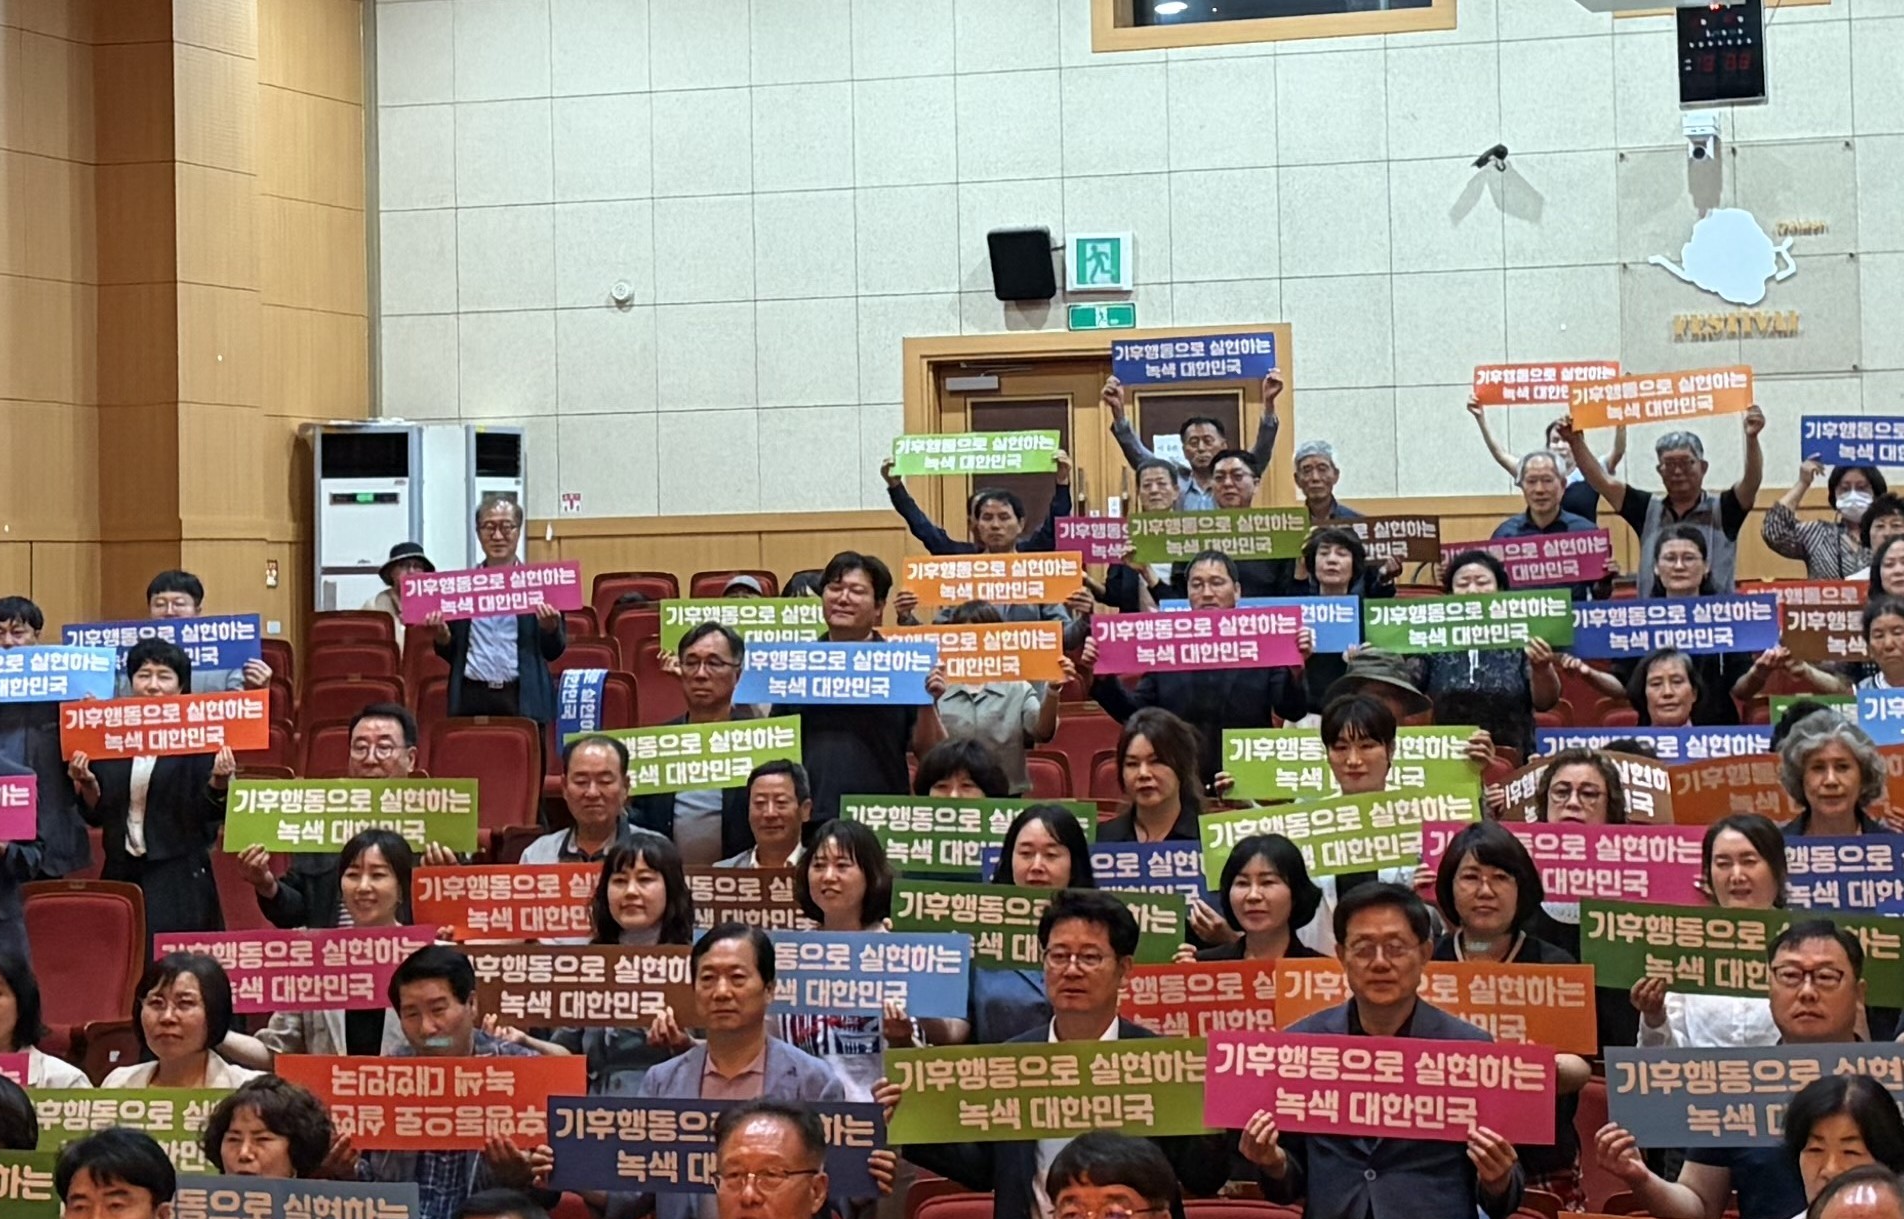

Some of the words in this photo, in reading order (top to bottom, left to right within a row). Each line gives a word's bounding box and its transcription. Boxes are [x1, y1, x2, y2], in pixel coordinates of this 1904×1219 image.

[1116, 342, 1205, 360] 기후행동으로
[1210, 338, 1270, 356] 실현하는
[1146, 363, 1176, 378] 녹색
[1181, 359, 1241, 376] 대한민국
[1573, 379, 1673, 404] 기후행동으로
[1679, 372, 1747, 393] 실현하는
[1607, 403, 1640, 420] 녹색
[1646, 395, 1713, 416] 대한민국
[896, 437, 987, 454] 기후행동으로
[993, 435, 1054, 451] 실현하는
[1839, 444, 1874, 461] 녹색
[924, 456, 955, 470] 녹색
[960, 454, 1021, 469] 대한민국
[1132, 516, 1231, 535] 기후행동으로
[1237, 514, 1304, 532] 실현하는
[1167, 539, 1199, 556] 녹색
[909, 561, 1006, 579] 기후행동으로
[1012, 559, 1077, 577] 실현하는
[406, 573, 505, 596] 기후행동으로
[510, 568, 575, 588] 실현하는
[940, 583, 973, 600] 녹색
[978, 581, 1044, 600] 대한민국
[441, 597, 474, 614] 녹색
[479, 591, 546, 611] 대한민국
[1370, 602, 1483, 625] 기후행동으로
[1489, 597, 1566, 619] 실현하는
[1572, 605, 1686, 628] 기후행동으로
[1693, 601, 1771, 622] 실현하는
[1097, 618, 1212, 641] 기후행동으로
[1219, 614, 1296, 636] 실현하는
[1409, 627, 1447, 647] 녹색
[1452, 623, 1528, 646] 대한민국
[1610, 631, 1649, 651] 녹색
[1655, 627, 1733, 649] 대한민국
[1137, 645, 1175, 665] 녹색
[1181, 641, 1258, 663] 대한민국
[66, 704, 180, 728] 기후행동으로
[187, 699, 263, 722] 실현하는
[105, 731, 143, 752] 녹색
[149, 726, 224, 749] 대한민국
[895, 1055, 1080, 1093] 기후행동으로
[1090, 1051, 1208, 1087] 실현하는
[1215, 1043, 1403, 1082] 기후행동으로
[1415, 1052, 1545, 1090] 실현하는
[959, 1098, 1021, 1130] 녹색
[1031, 1094, 1154, 1128] 대한민국
[1276, 1087, 1339, 1123] 녹색
[1350, 1092, 1480, 1131] 대한민국
